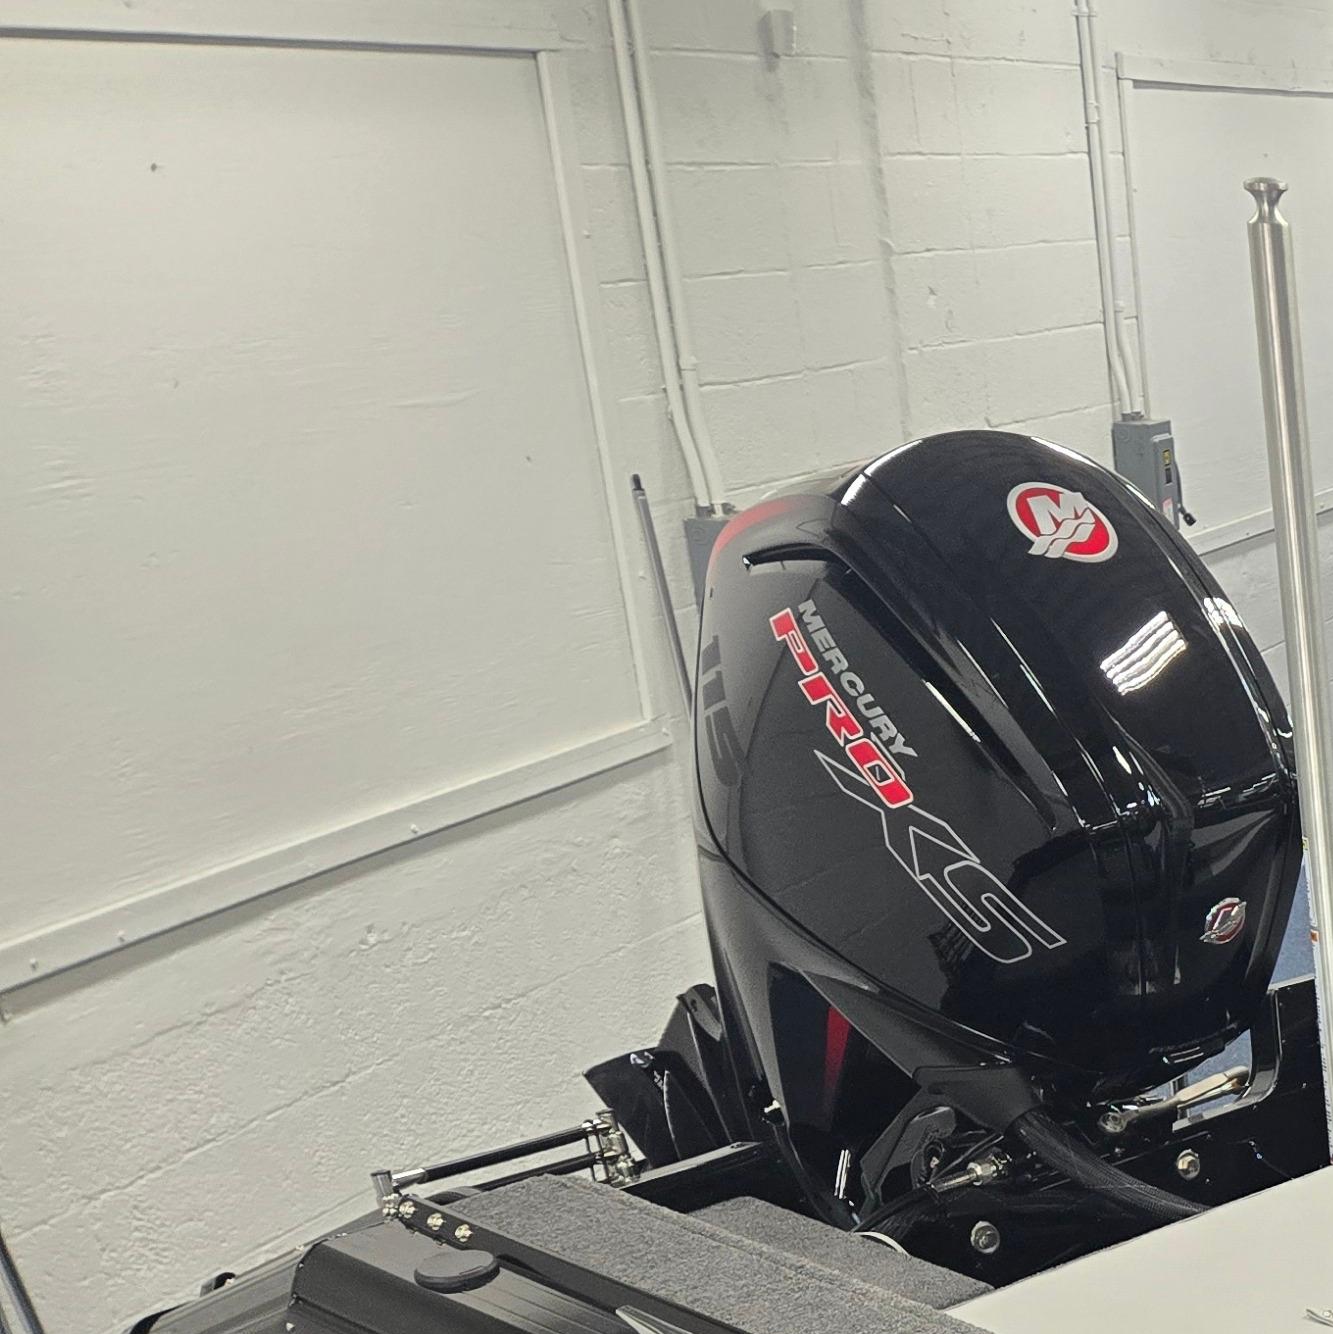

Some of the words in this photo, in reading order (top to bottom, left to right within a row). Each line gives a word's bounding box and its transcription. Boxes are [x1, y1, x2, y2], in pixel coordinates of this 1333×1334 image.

[768, 607, 914, 809] PRO
[797, 599, 917, 759] MERCURY
[813, 749, 1067, 964] XS
